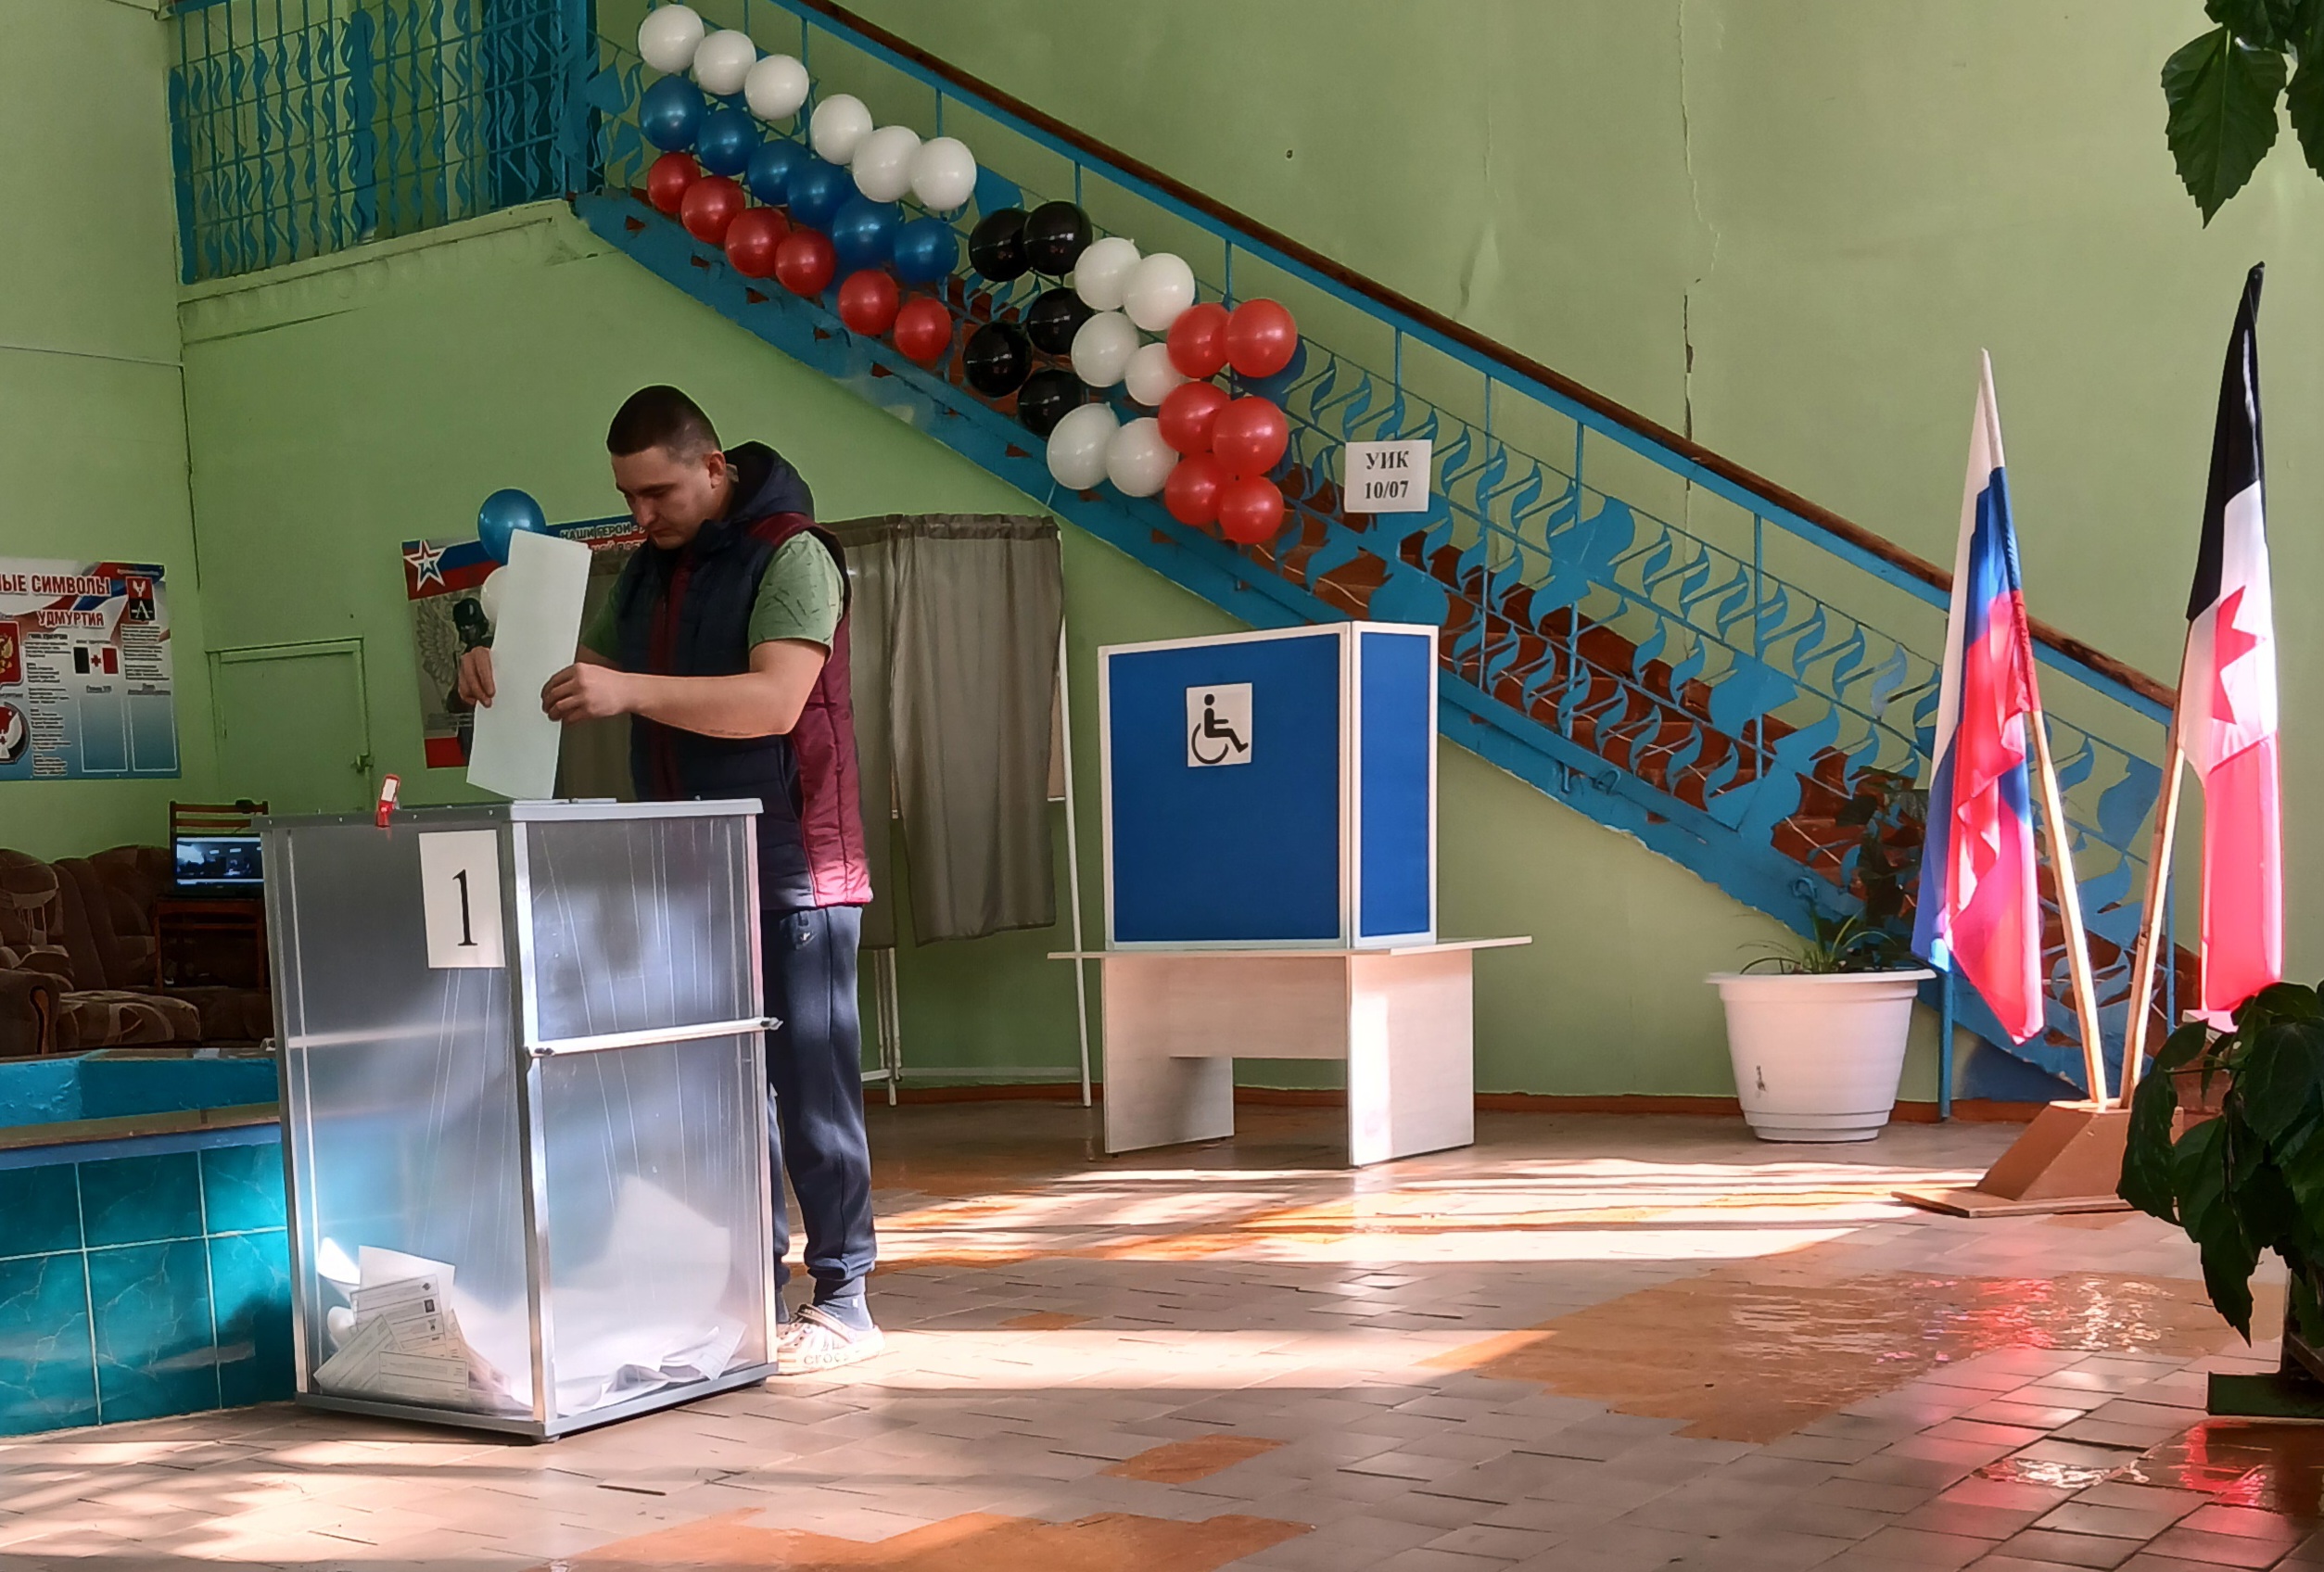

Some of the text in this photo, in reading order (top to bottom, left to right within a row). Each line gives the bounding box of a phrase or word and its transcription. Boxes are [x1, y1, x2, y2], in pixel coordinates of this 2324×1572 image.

[1365, 450, 1409, 470] УИК
[1365, 481, 1409, 499] 10/07
[595, 521, 631, 538] ГЕРОИ
[0, 574, 111, 594] ЫЕ СИМВОЛЫ
[38, 612, 105, 627] УДМУРТИЯ
[452, 868, 478, 946] 1
